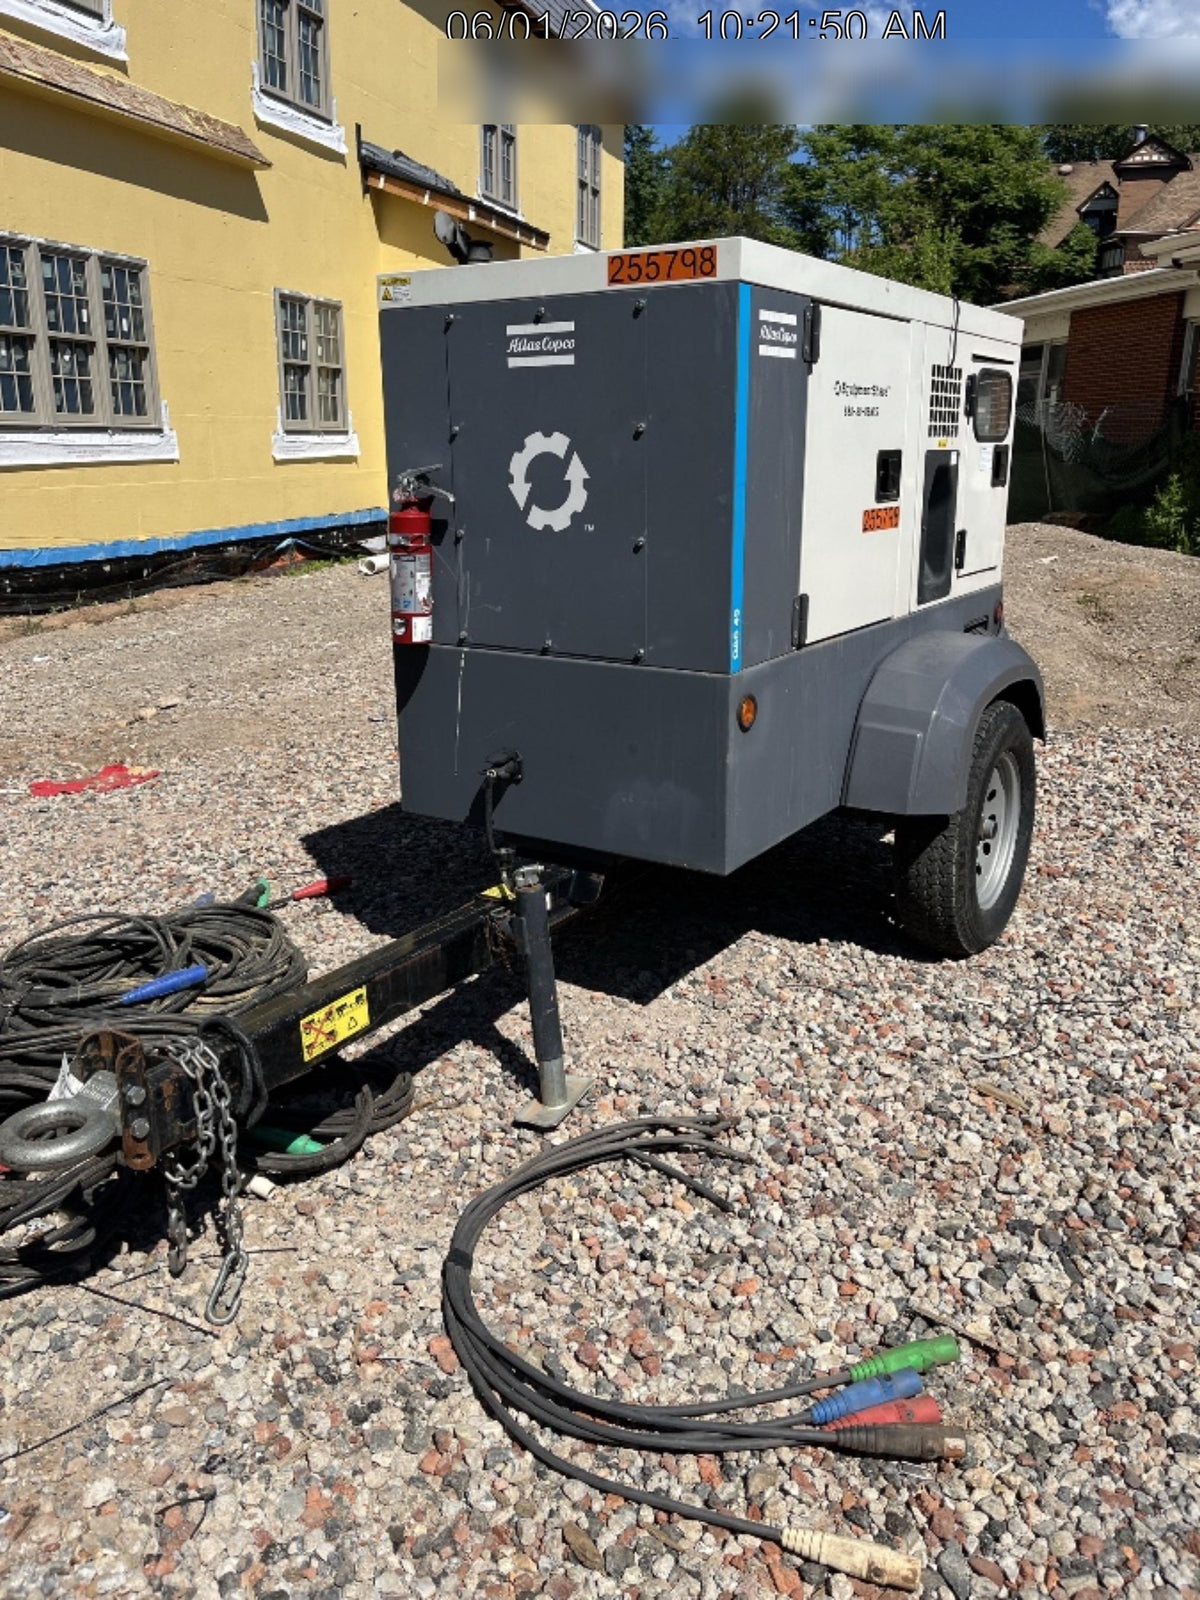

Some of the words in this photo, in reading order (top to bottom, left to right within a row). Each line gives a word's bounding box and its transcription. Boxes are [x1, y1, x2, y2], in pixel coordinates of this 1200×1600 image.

[609, 247, 715, 283] 255798
[506, 337, 540, 353] Atlas
[541, 336, 575, 352] Copco
